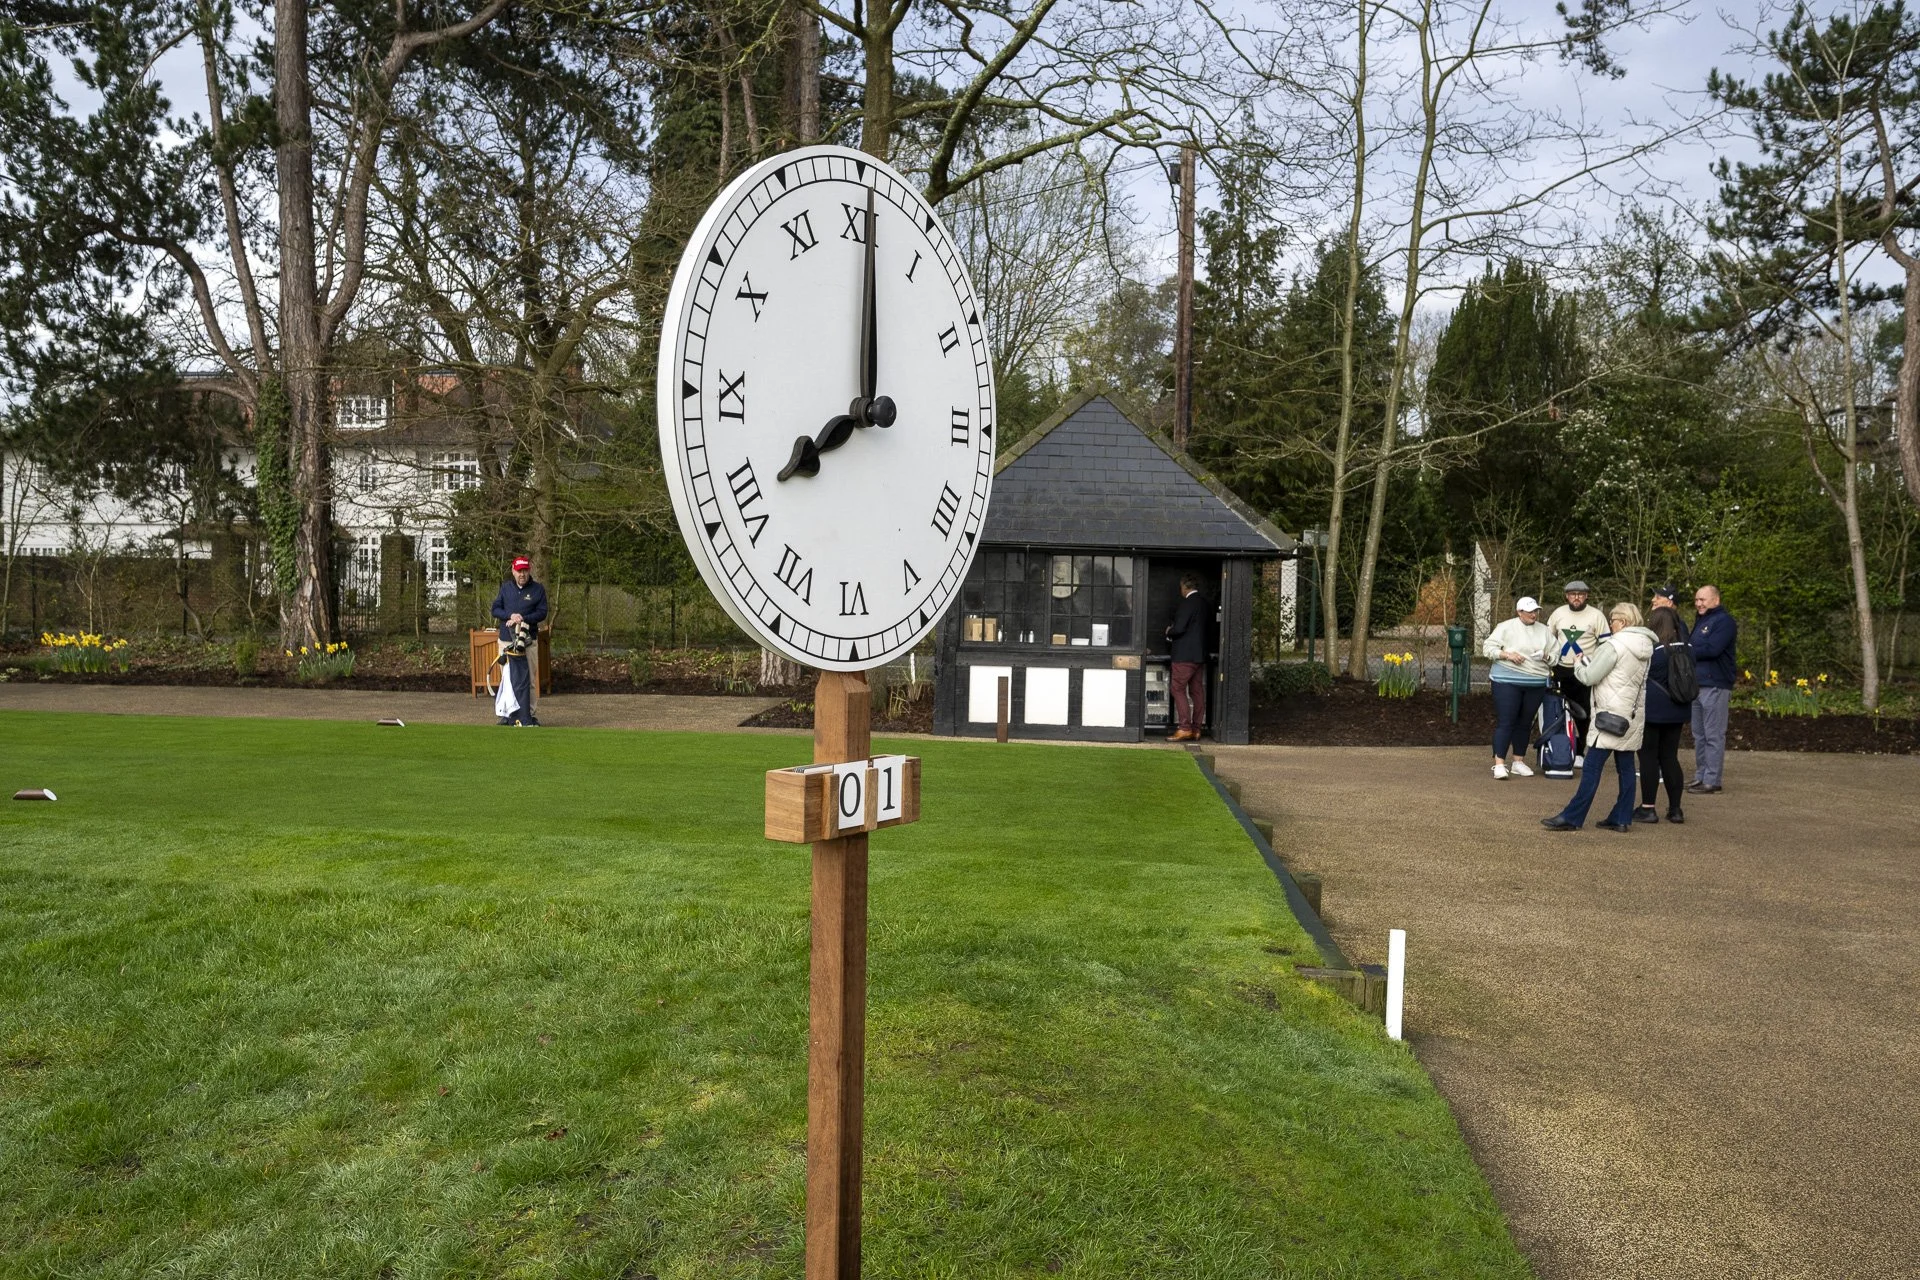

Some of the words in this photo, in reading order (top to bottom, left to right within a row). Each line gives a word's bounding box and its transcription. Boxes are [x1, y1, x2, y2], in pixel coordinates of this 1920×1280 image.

[781, 209, 819, 260] XI
[905, 250, 922, 283] I
[735, 271, 768, 322] X
[938, 321, 960, 358] II
[719, 369, 745, 424] IX
[951, 406, 970, 448] III
[726, 456, 769, 549] VIII
[931, 480, 962, 541] IIII
[773, 544, 813, 606] VII
[839, 582, 869, 616] VI
[903, 559, 921, 595] V
